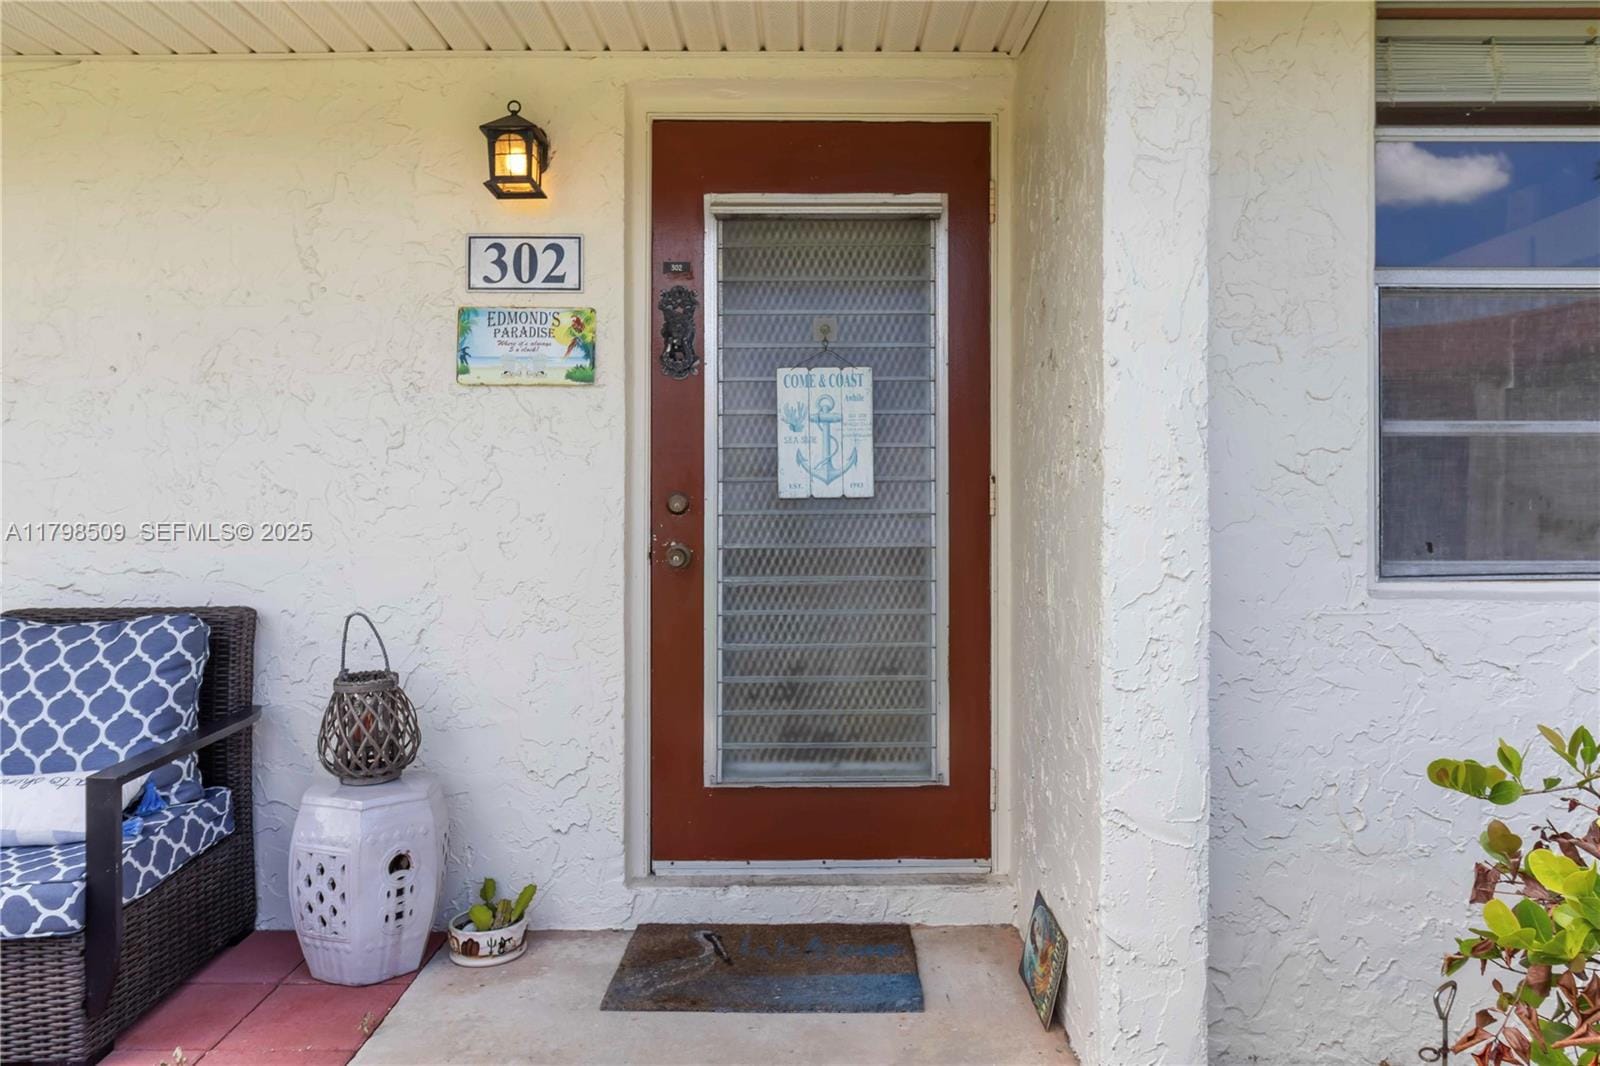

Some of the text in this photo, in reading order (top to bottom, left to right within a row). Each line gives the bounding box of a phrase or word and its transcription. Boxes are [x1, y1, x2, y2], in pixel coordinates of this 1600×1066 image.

[482, 242, 567, 284] 302
[671, 263, 683, 272] 302
[487, 311, 561, 327] EDMOND'S
[493, 327, 556, 339] PARADISE
[783, 373, 864, 389] COME & COAST
